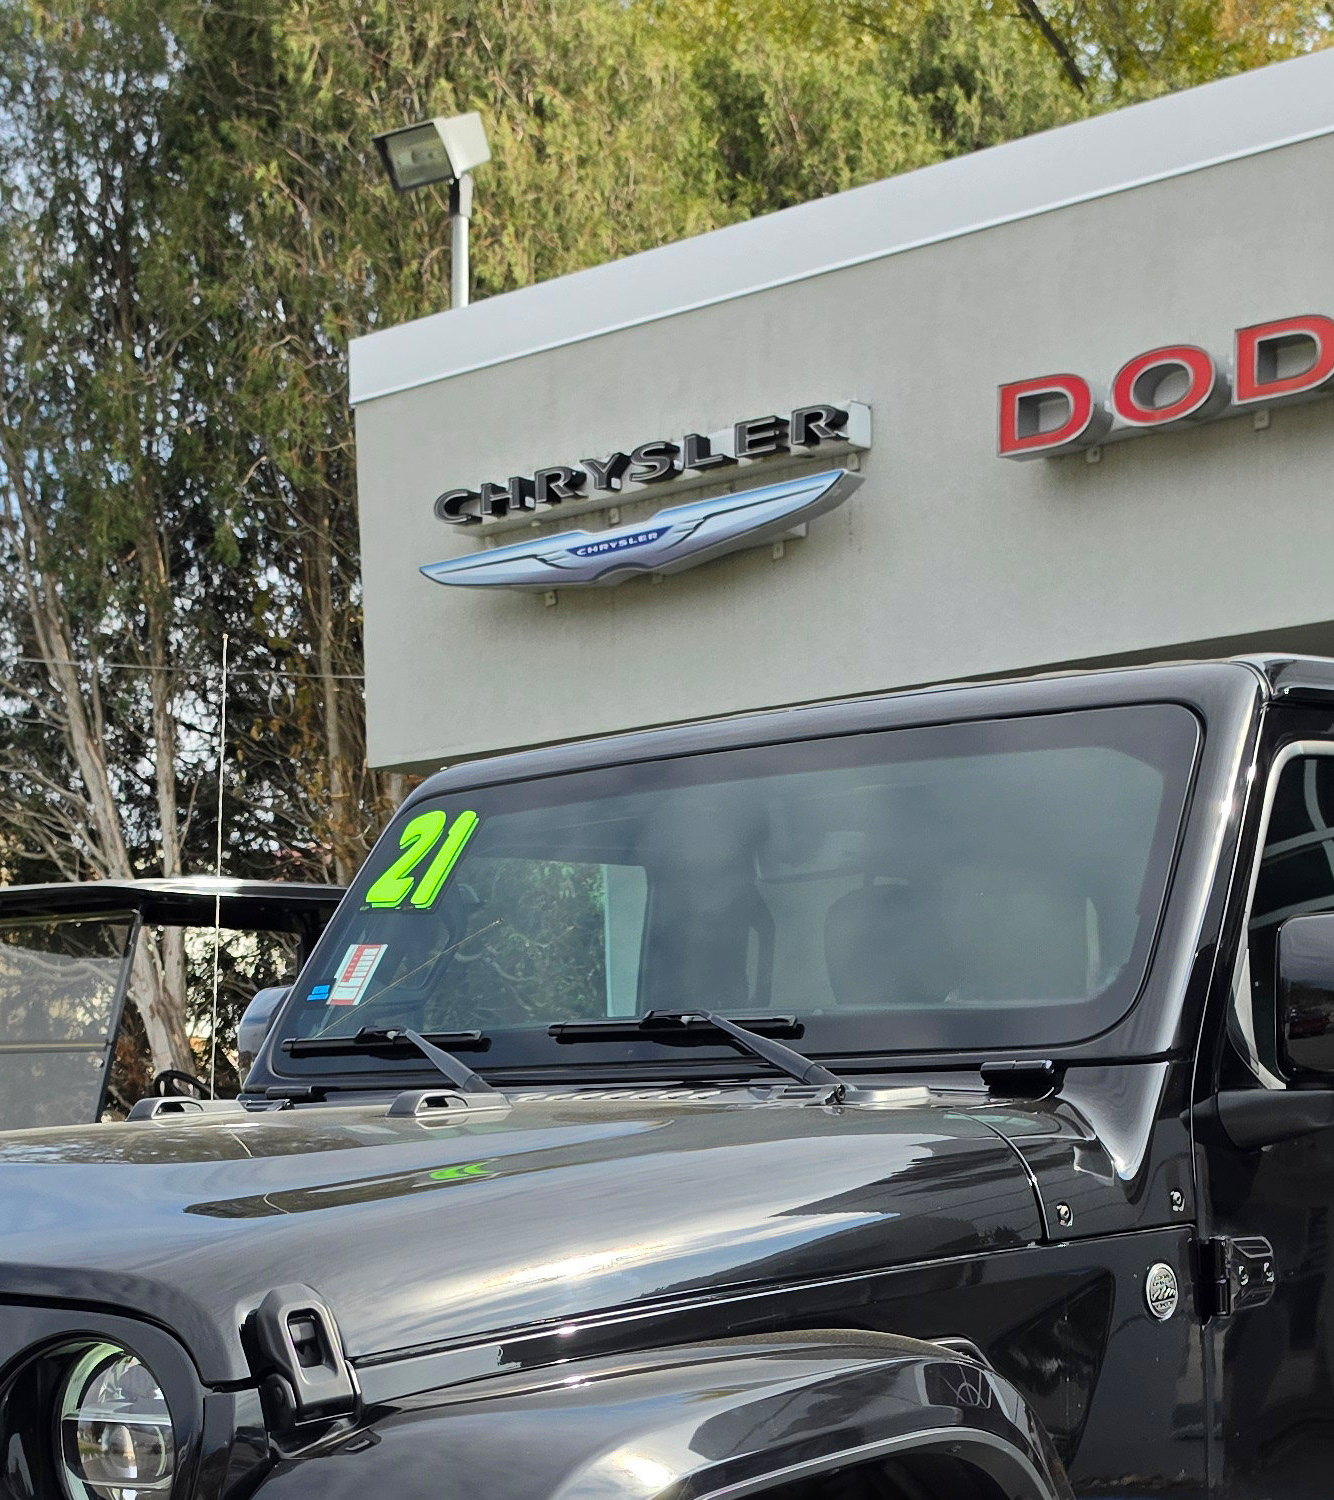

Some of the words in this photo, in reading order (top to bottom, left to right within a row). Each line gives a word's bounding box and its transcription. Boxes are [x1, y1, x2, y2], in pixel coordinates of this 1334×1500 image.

[433, 403, 851, 525] CHRYSLER
[576, 532, 658, 556] CHRYSLER
[365, 810, 479, 910] 21
